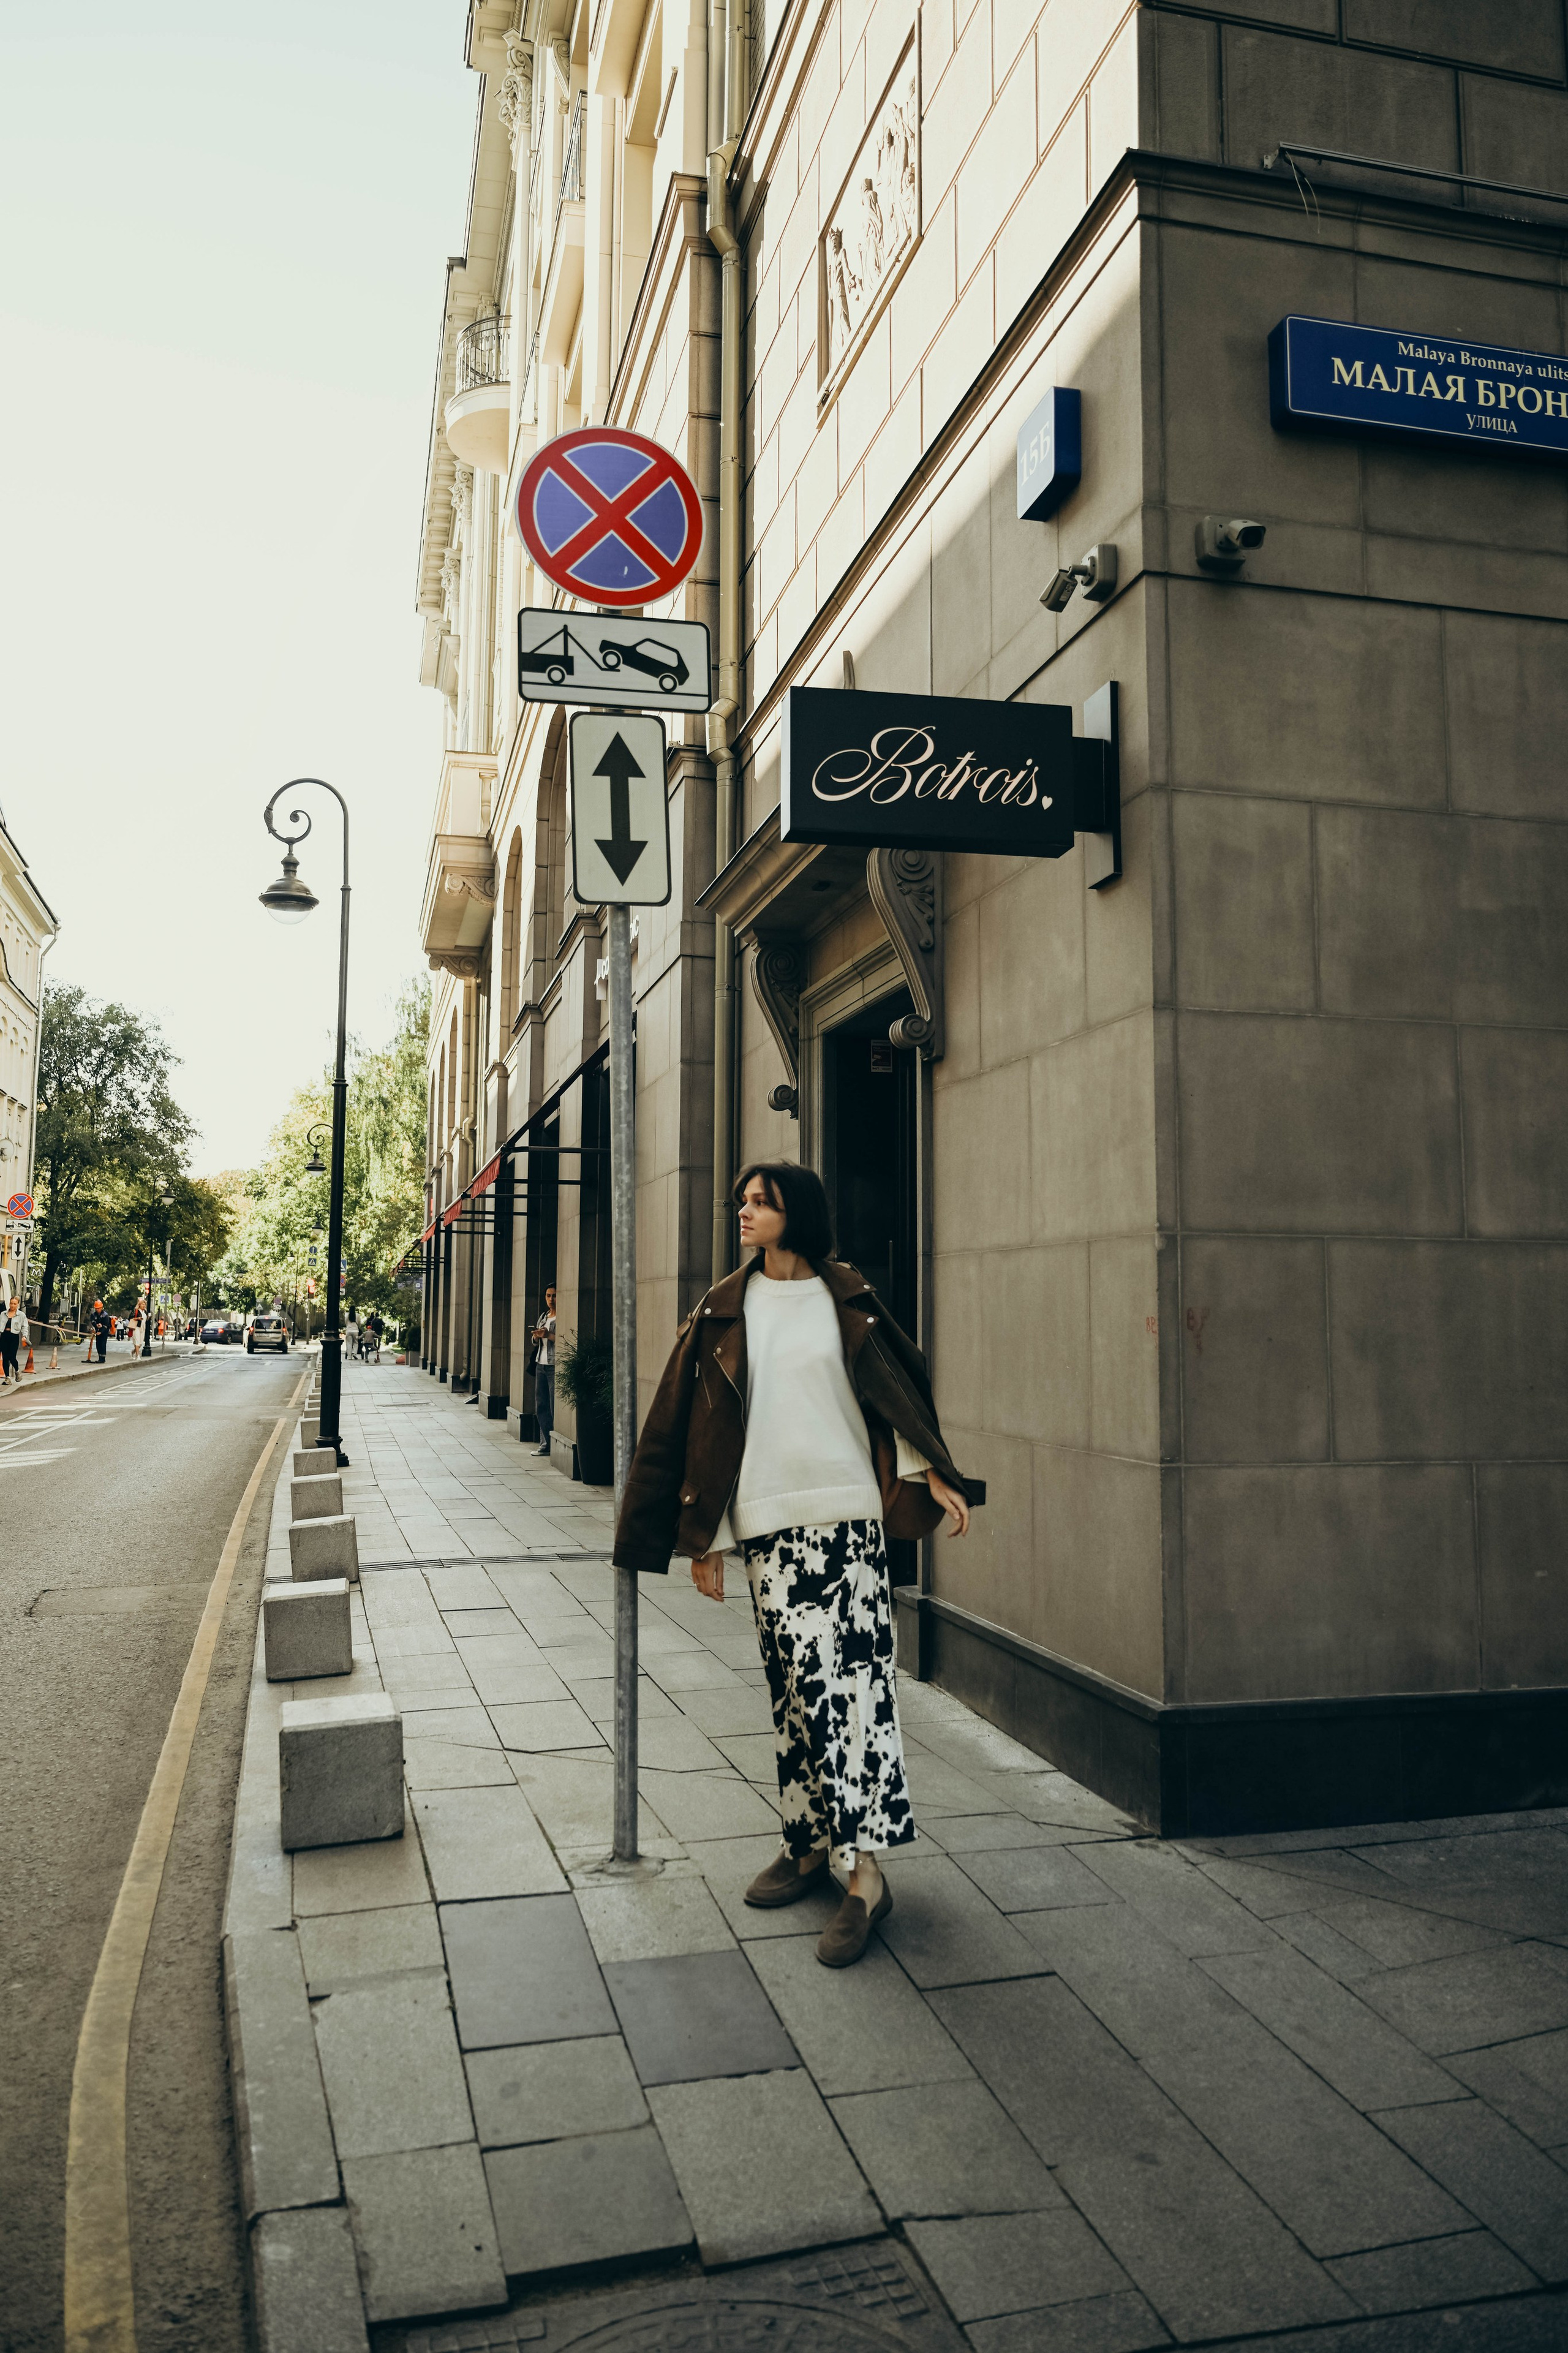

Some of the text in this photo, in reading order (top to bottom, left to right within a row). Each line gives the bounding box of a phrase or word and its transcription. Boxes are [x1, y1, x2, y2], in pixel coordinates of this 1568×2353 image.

[1332, 357, 1568, 418] МАЛАЯ БРОН
[1398, 341, 1455, 365] Malaya
[1460, 351, 1533, 377] Bronnaya
[1020, 420, 1050, 486] 15Б
